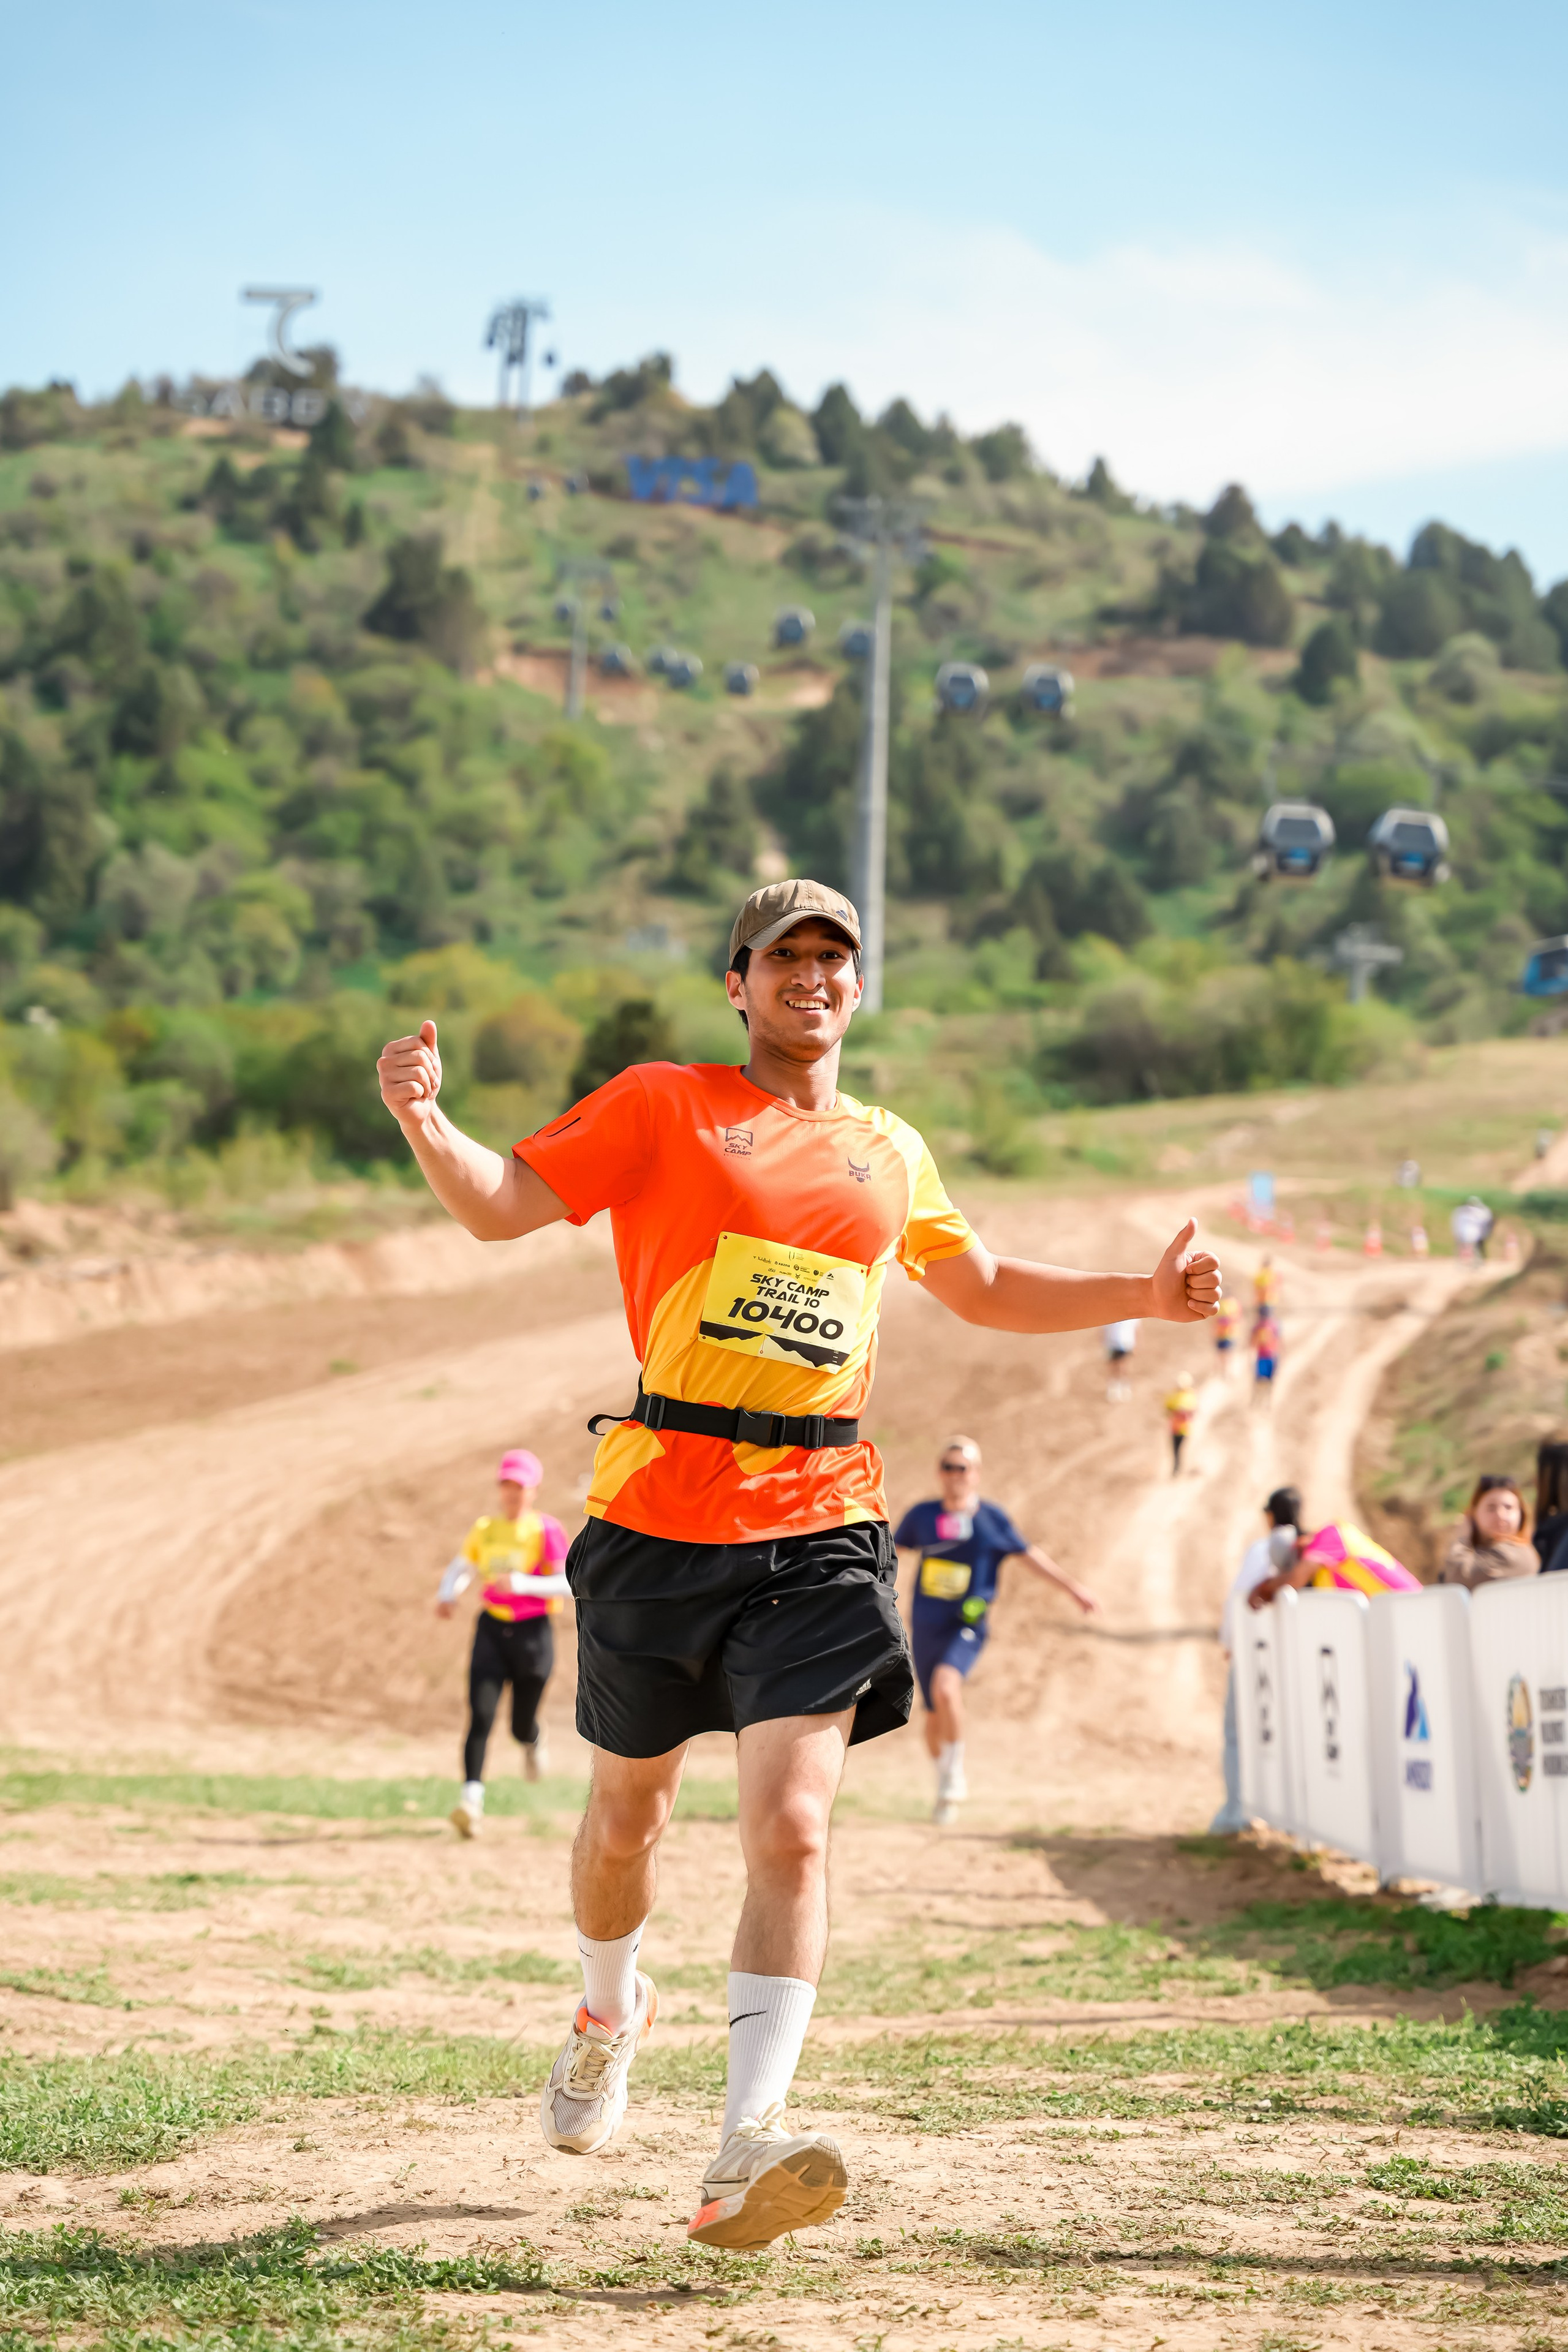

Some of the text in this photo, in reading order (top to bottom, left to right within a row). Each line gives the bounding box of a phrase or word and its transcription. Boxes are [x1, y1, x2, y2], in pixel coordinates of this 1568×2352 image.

[724, 1147, 752, 1156] CAMP
[750, 1273, 830, 1298] SKY CAMP
[756, 1286, 820, 1308] TRAIL 10
[727, 1297, 844, 1340] 10400
